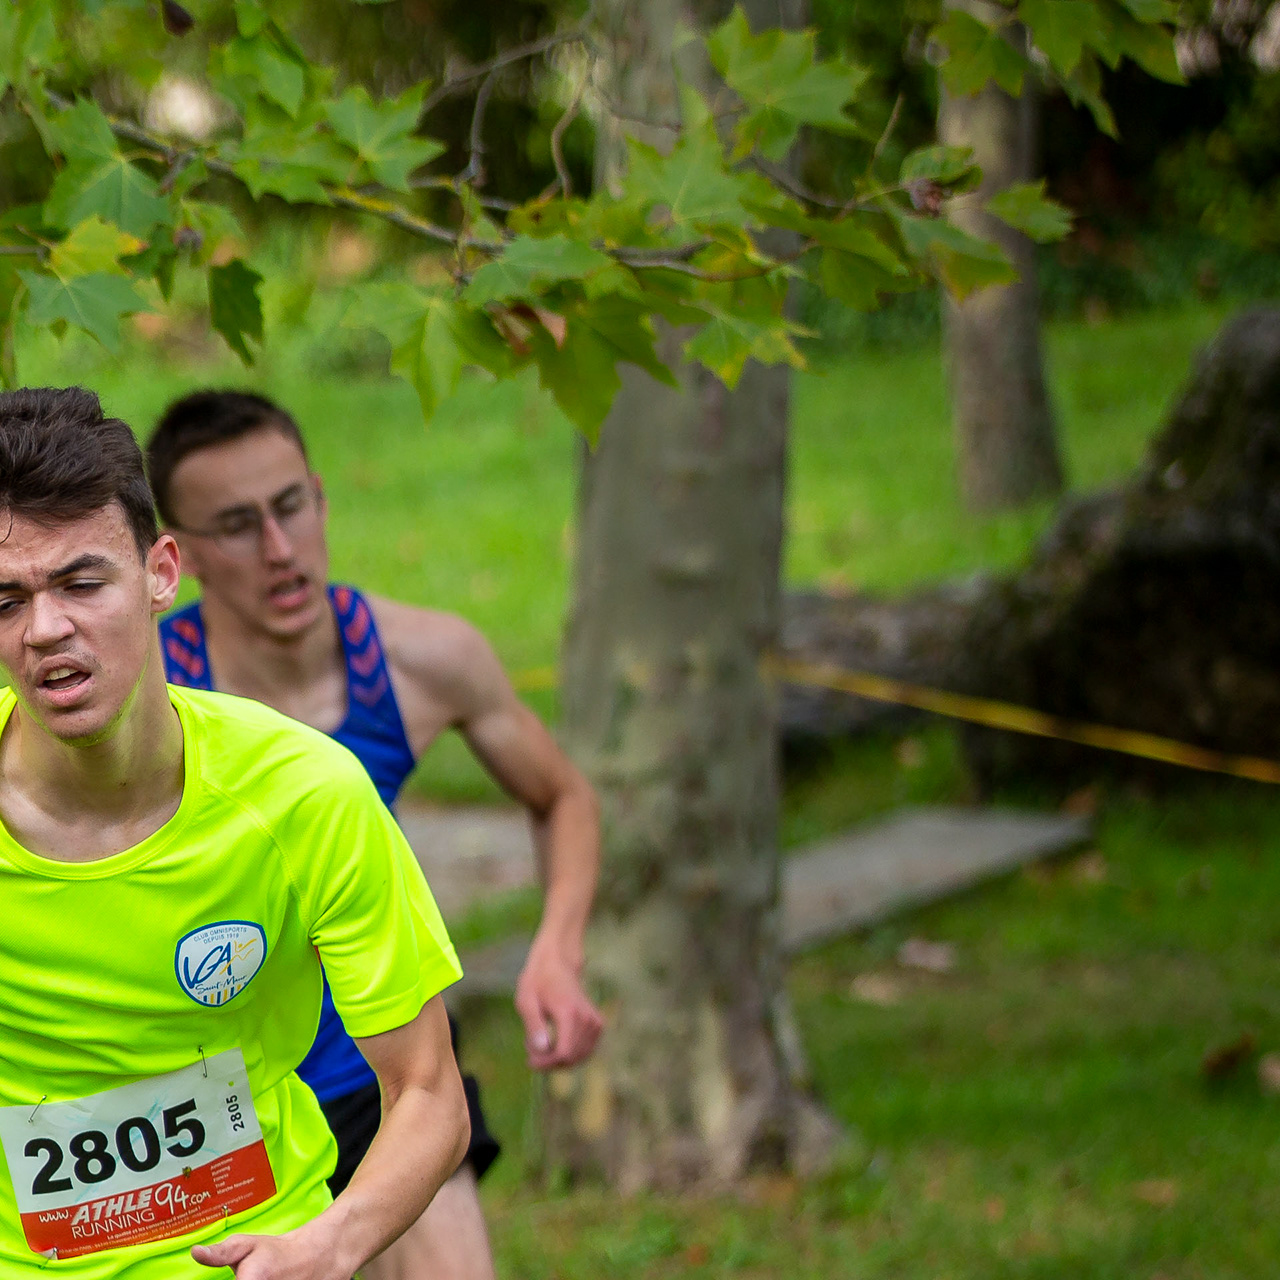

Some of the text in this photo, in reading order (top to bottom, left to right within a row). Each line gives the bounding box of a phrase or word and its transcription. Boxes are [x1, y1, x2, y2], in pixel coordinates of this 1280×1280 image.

[193, 926, 248, 942] CLUB OMNISPORTS
[203, 933, 225, 945] DEPUIS
[226, 1094, 245, 1131] 2805
[23, 1097, 206, 1195] 2805
[71, 1207, 156, 1239] RUNNING
